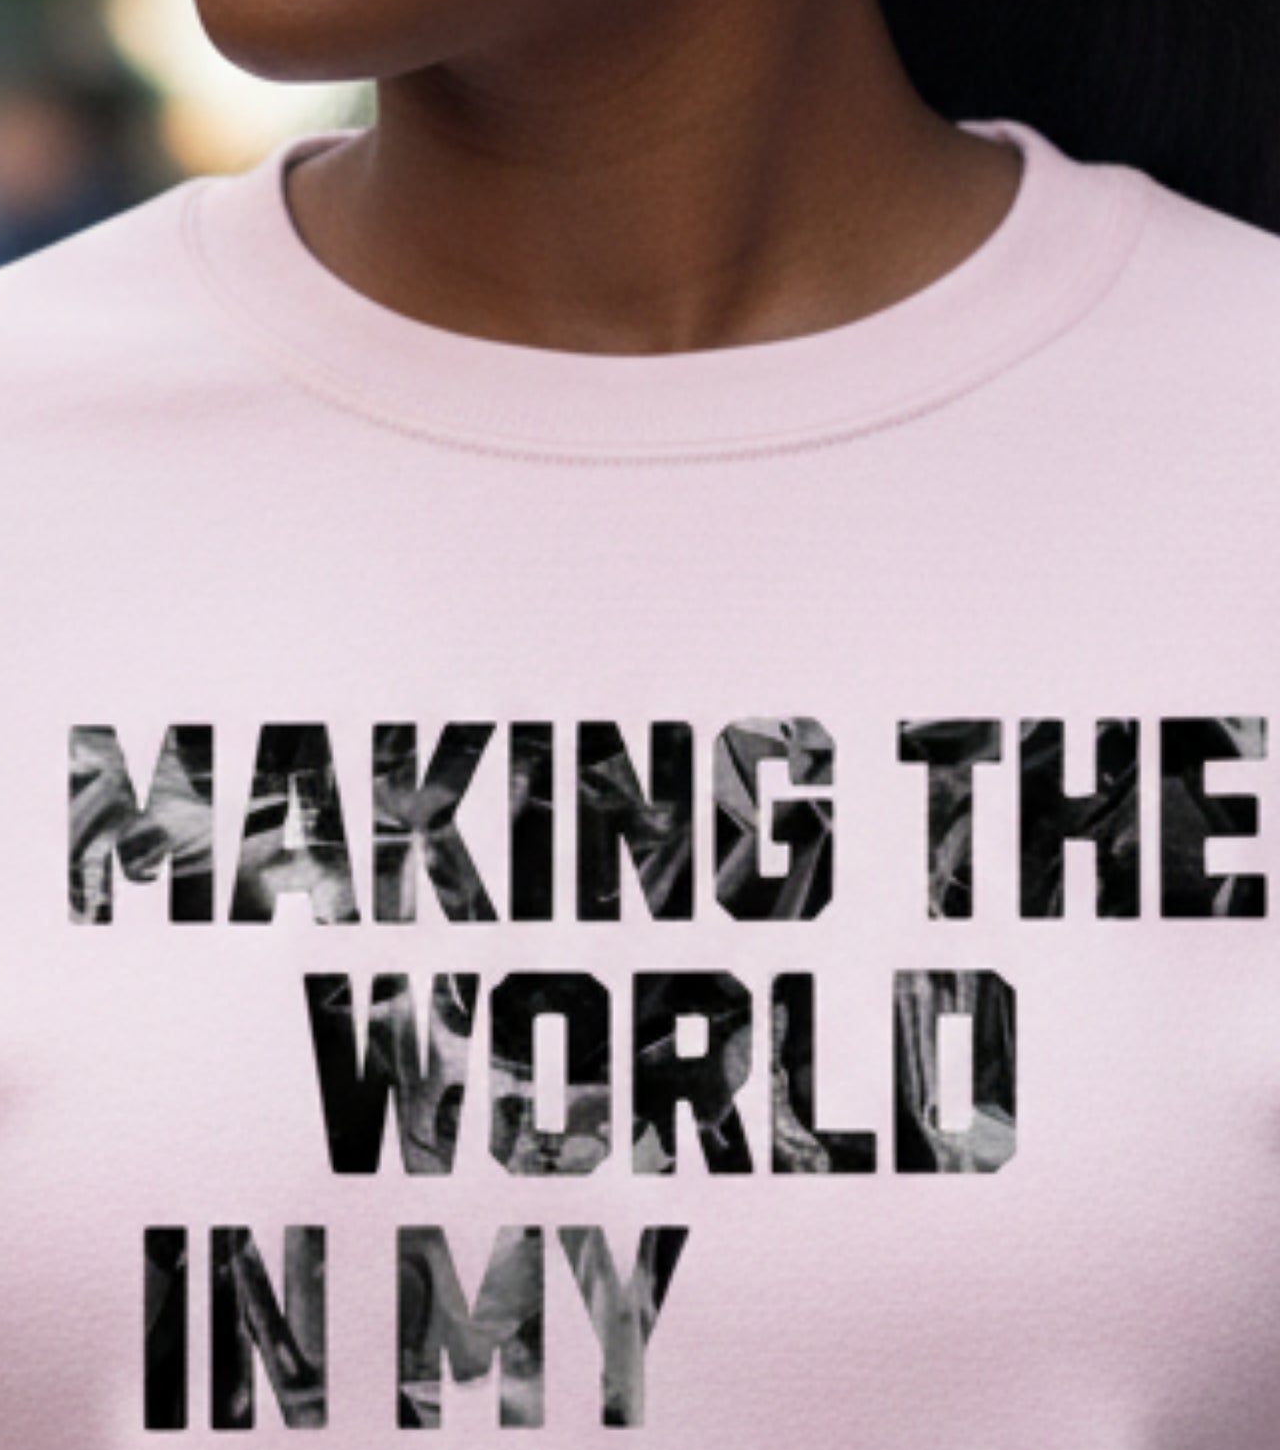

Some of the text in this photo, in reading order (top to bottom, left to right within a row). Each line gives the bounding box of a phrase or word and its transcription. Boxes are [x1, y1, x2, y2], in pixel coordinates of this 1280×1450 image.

[67, 716, 1269, 926] MAKING THE
[303, 969, 1018, 1176] WORLD
[143, 1225, 690, 1431] IN MY
